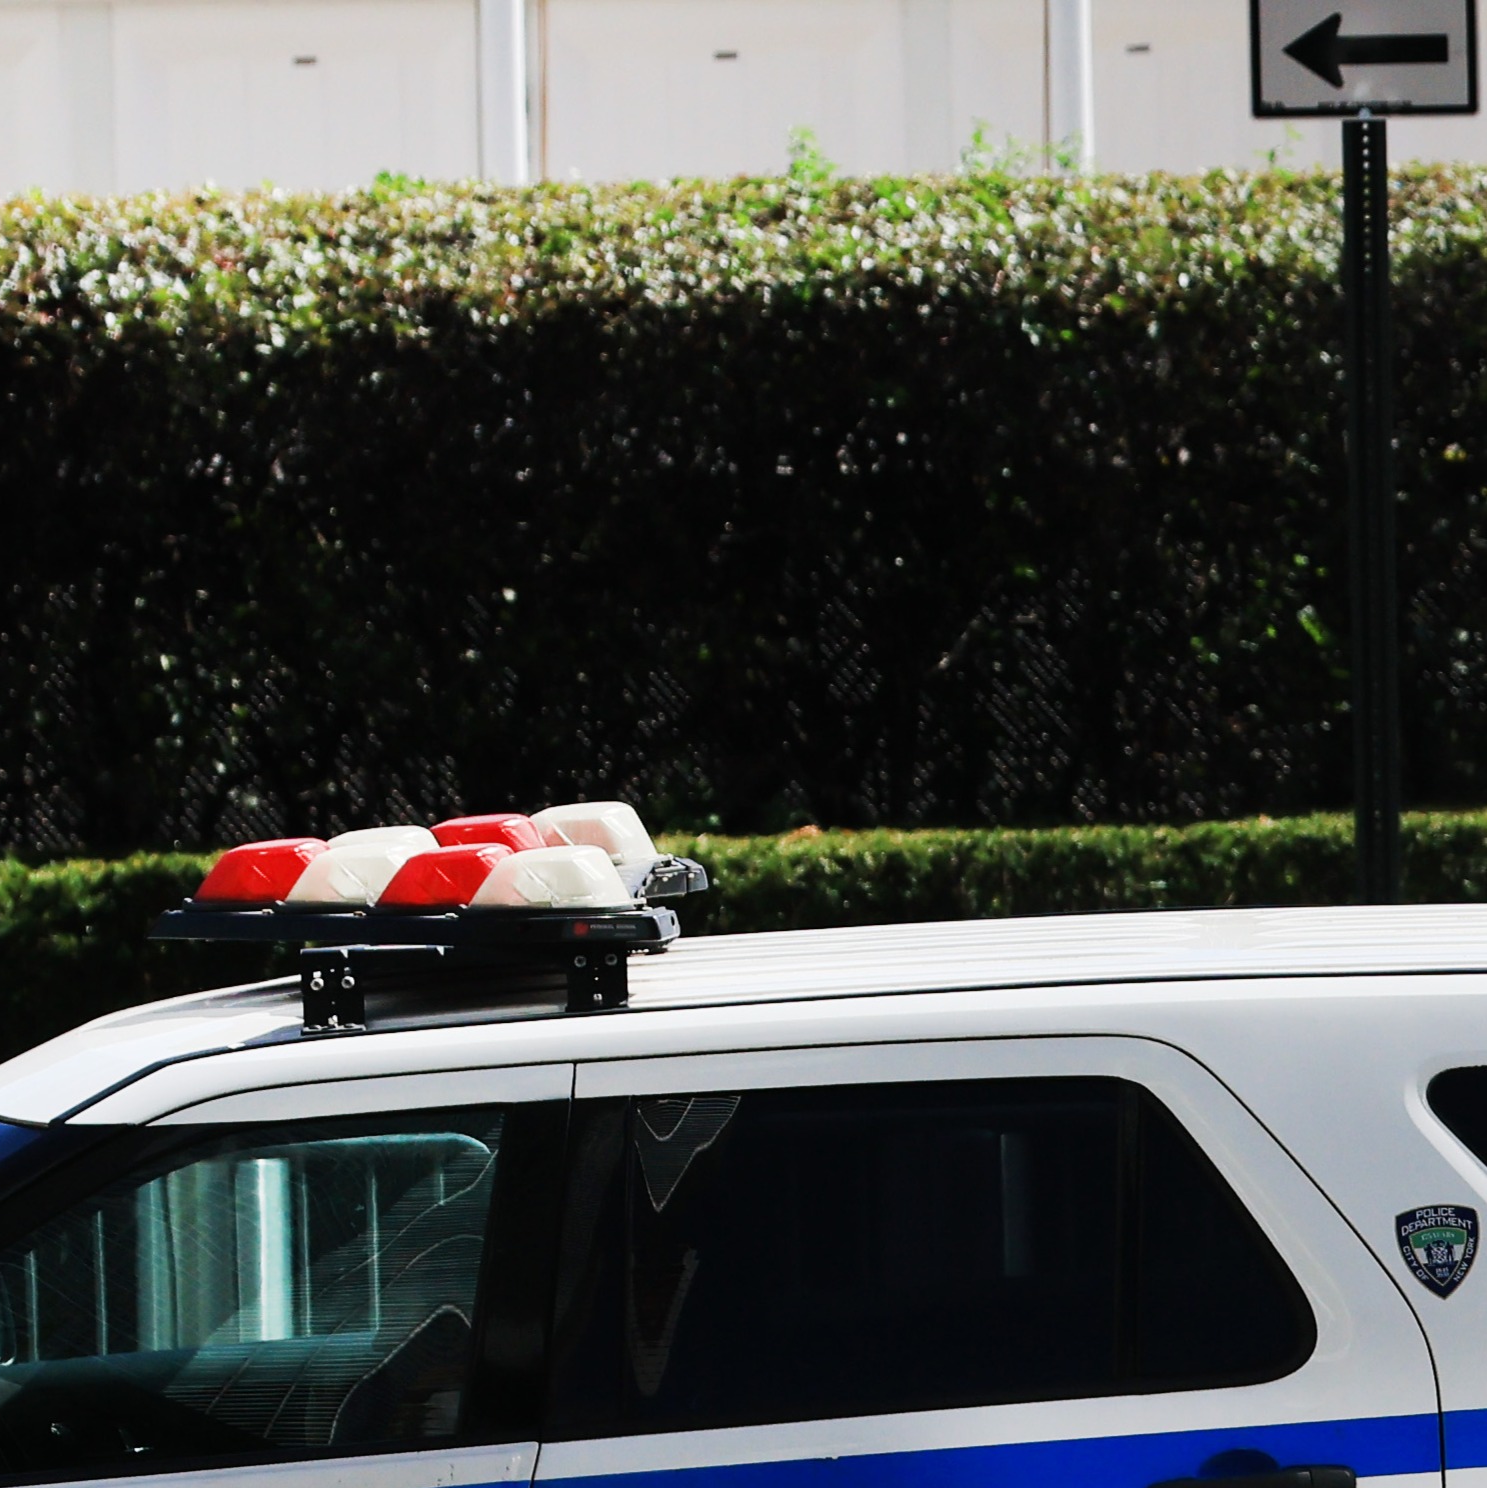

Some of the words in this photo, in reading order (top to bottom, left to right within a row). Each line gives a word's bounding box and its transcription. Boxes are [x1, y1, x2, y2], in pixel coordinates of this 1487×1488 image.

[1415, 1207, 1456, 1220] POLICE
[1401, 1217, 1473, 1237] DEPARTMENT
[1402, 1245, 1418, 1268] CITY
[1416, 1268, 1430, 1282] OF
[1453, 1262, 1469, 1282] NEW
[1465, 1237, 1475, 1258] YORK
